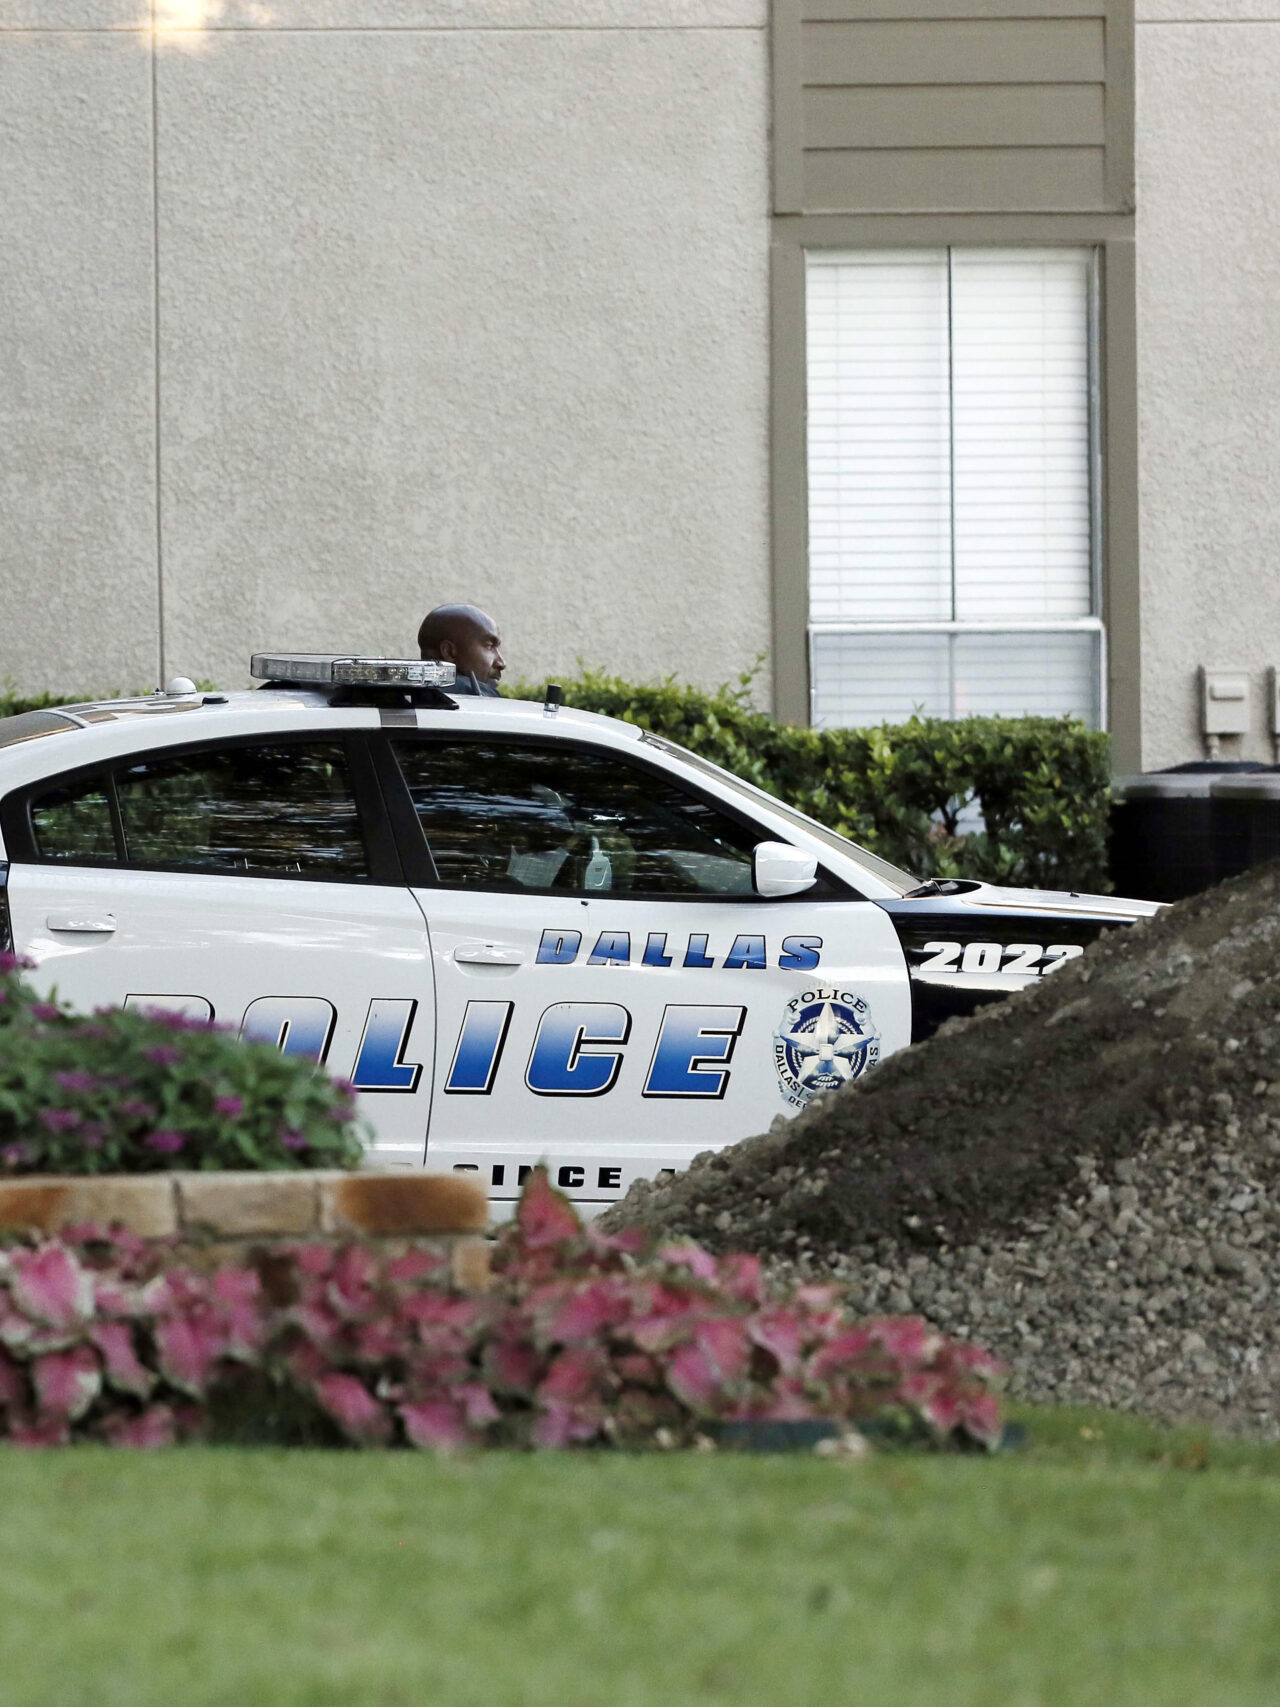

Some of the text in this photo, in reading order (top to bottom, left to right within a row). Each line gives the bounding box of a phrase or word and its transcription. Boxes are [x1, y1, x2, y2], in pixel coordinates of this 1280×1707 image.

[535, 929, 823, 970] DALLAS
[786, 988, 868, 1014] POLICE
[123, 993, 747, 1099] OLICE
[775, 1044, 801, 1093] DALLAS
[452, 1163, 622, 1189] ICE
